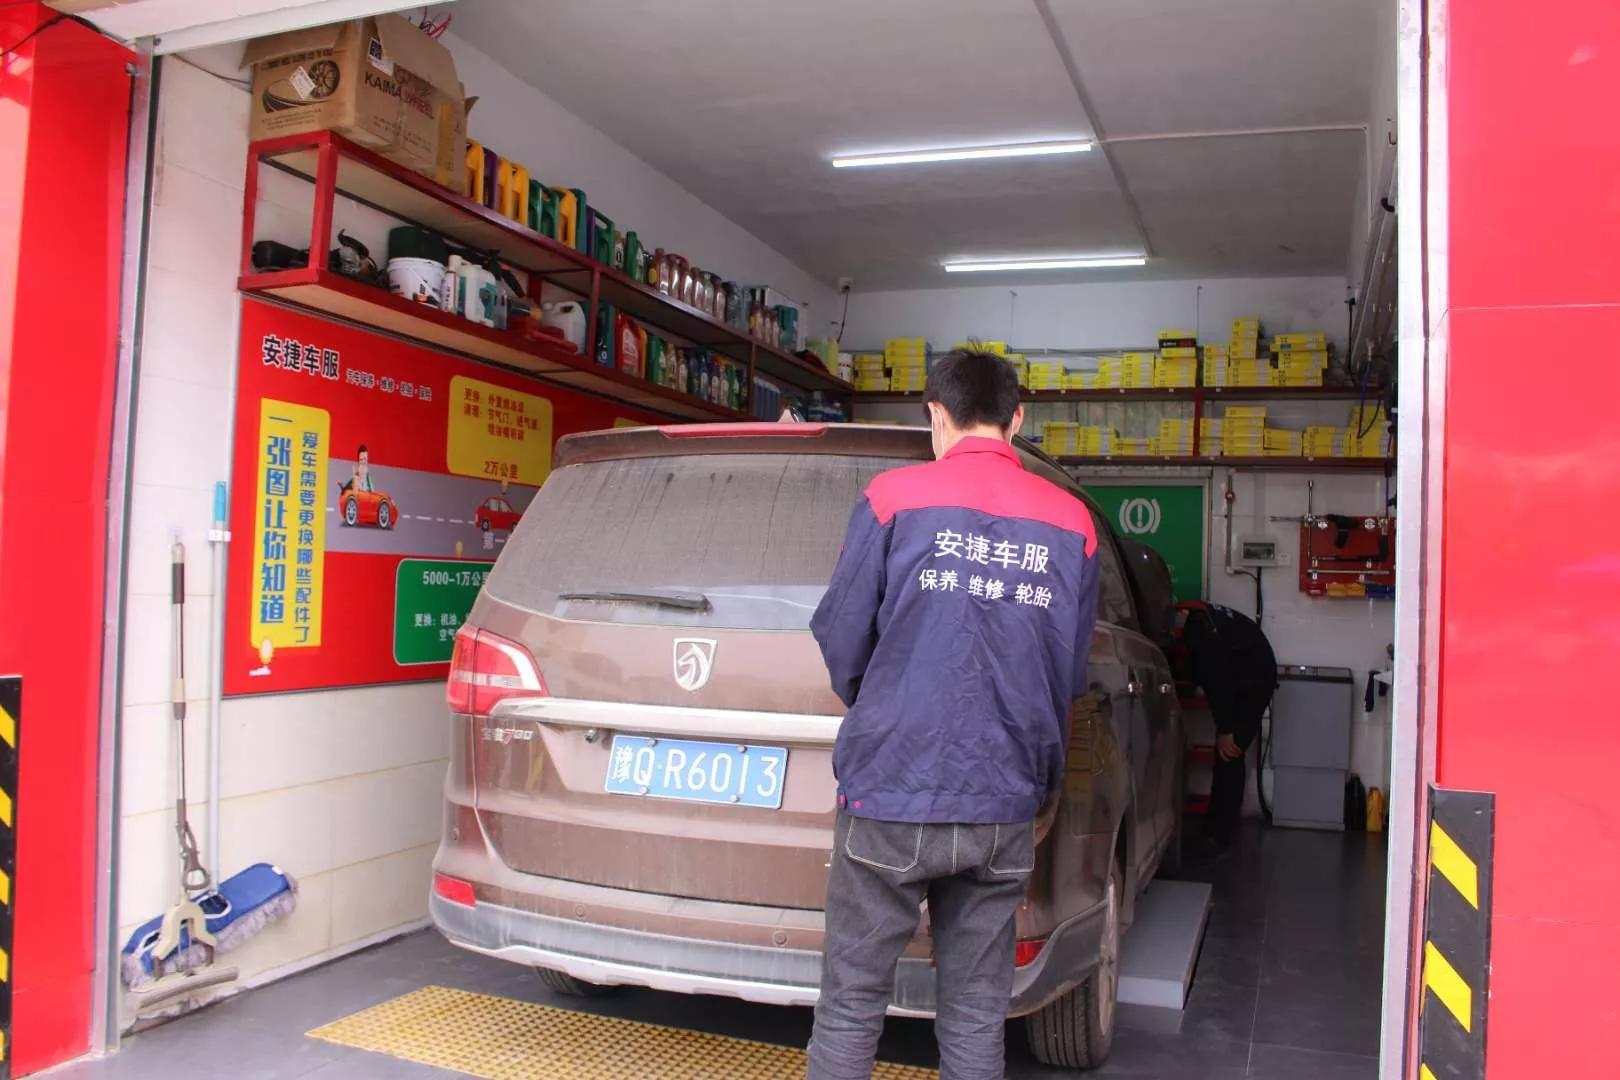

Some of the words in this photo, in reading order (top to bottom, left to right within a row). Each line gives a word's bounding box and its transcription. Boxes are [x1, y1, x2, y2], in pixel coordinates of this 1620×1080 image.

[262, 334, 341, 380] 安捷车服
[259, 415, 294, 624] 一张图让你知道
[294, 431, 319, 643] 爱车需要更换哪些配件了
[934, 529, 1049, 574] 安捷车服
[919, 568, 959, 592] 保养
[968, 574, 1005, 600] 维修
[1015, 582, 1052, 608] 轮胎
